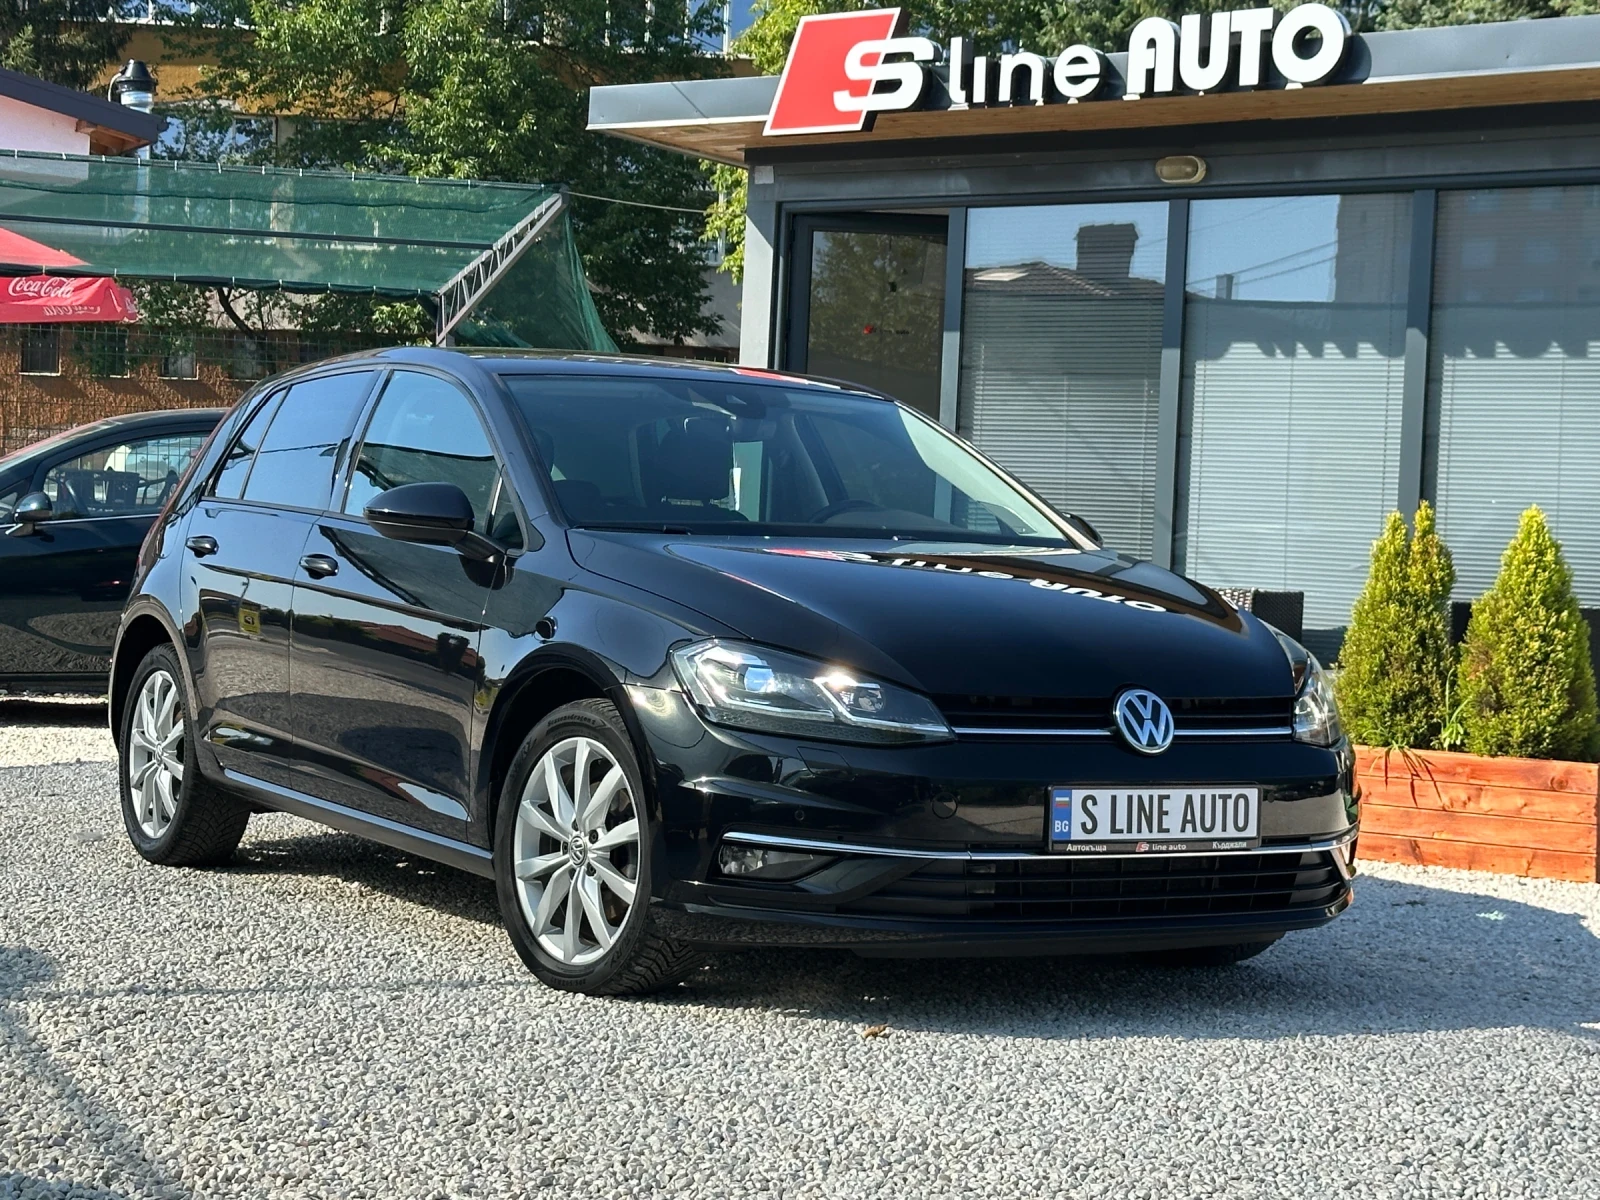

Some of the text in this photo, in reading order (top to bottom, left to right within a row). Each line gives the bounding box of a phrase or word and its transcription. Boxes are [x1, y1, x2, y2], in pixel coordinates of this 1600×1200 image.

[833, 4, 1346, 113] S line AUTO
[8, 276, 76, 298] Coca-Cola
[1080, 793, 1249, 835] S LINE AUTO
[1054, 820, 1069, 833] BG
[1066, 843, 1107, 852] Автокъща
[1152, 843, 1167, 851] line
[1168, 843, 1187, 851] auto
